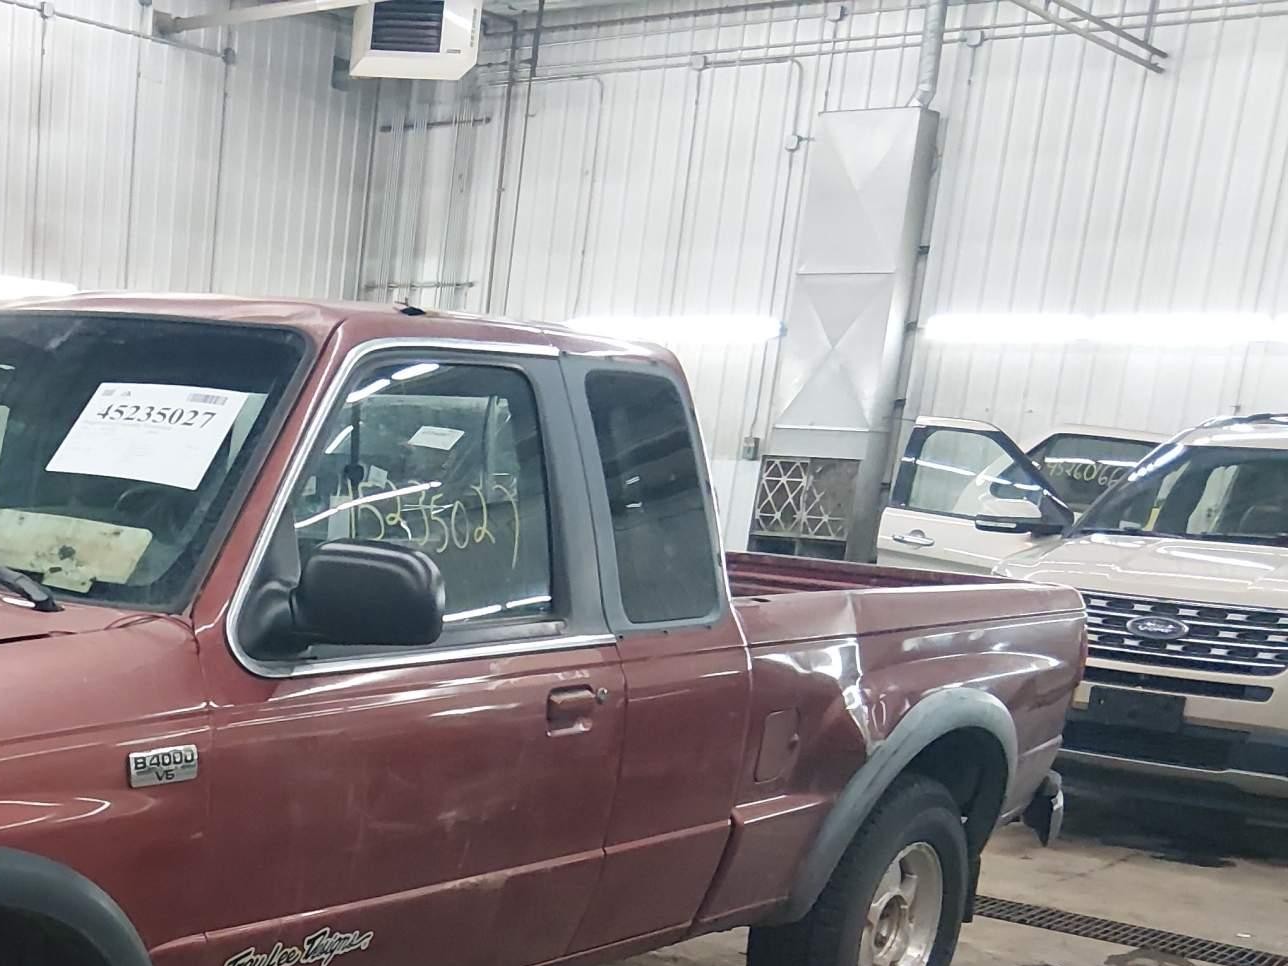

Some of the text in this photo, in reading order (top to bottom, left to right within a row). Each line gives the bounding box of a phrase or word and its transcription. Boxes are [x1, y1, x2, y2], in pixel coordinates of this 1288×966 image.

[97, 403, 217, 428] 45235027
[134, 749, 194, 770] B4000
[155, 769, 175, 781] V6
